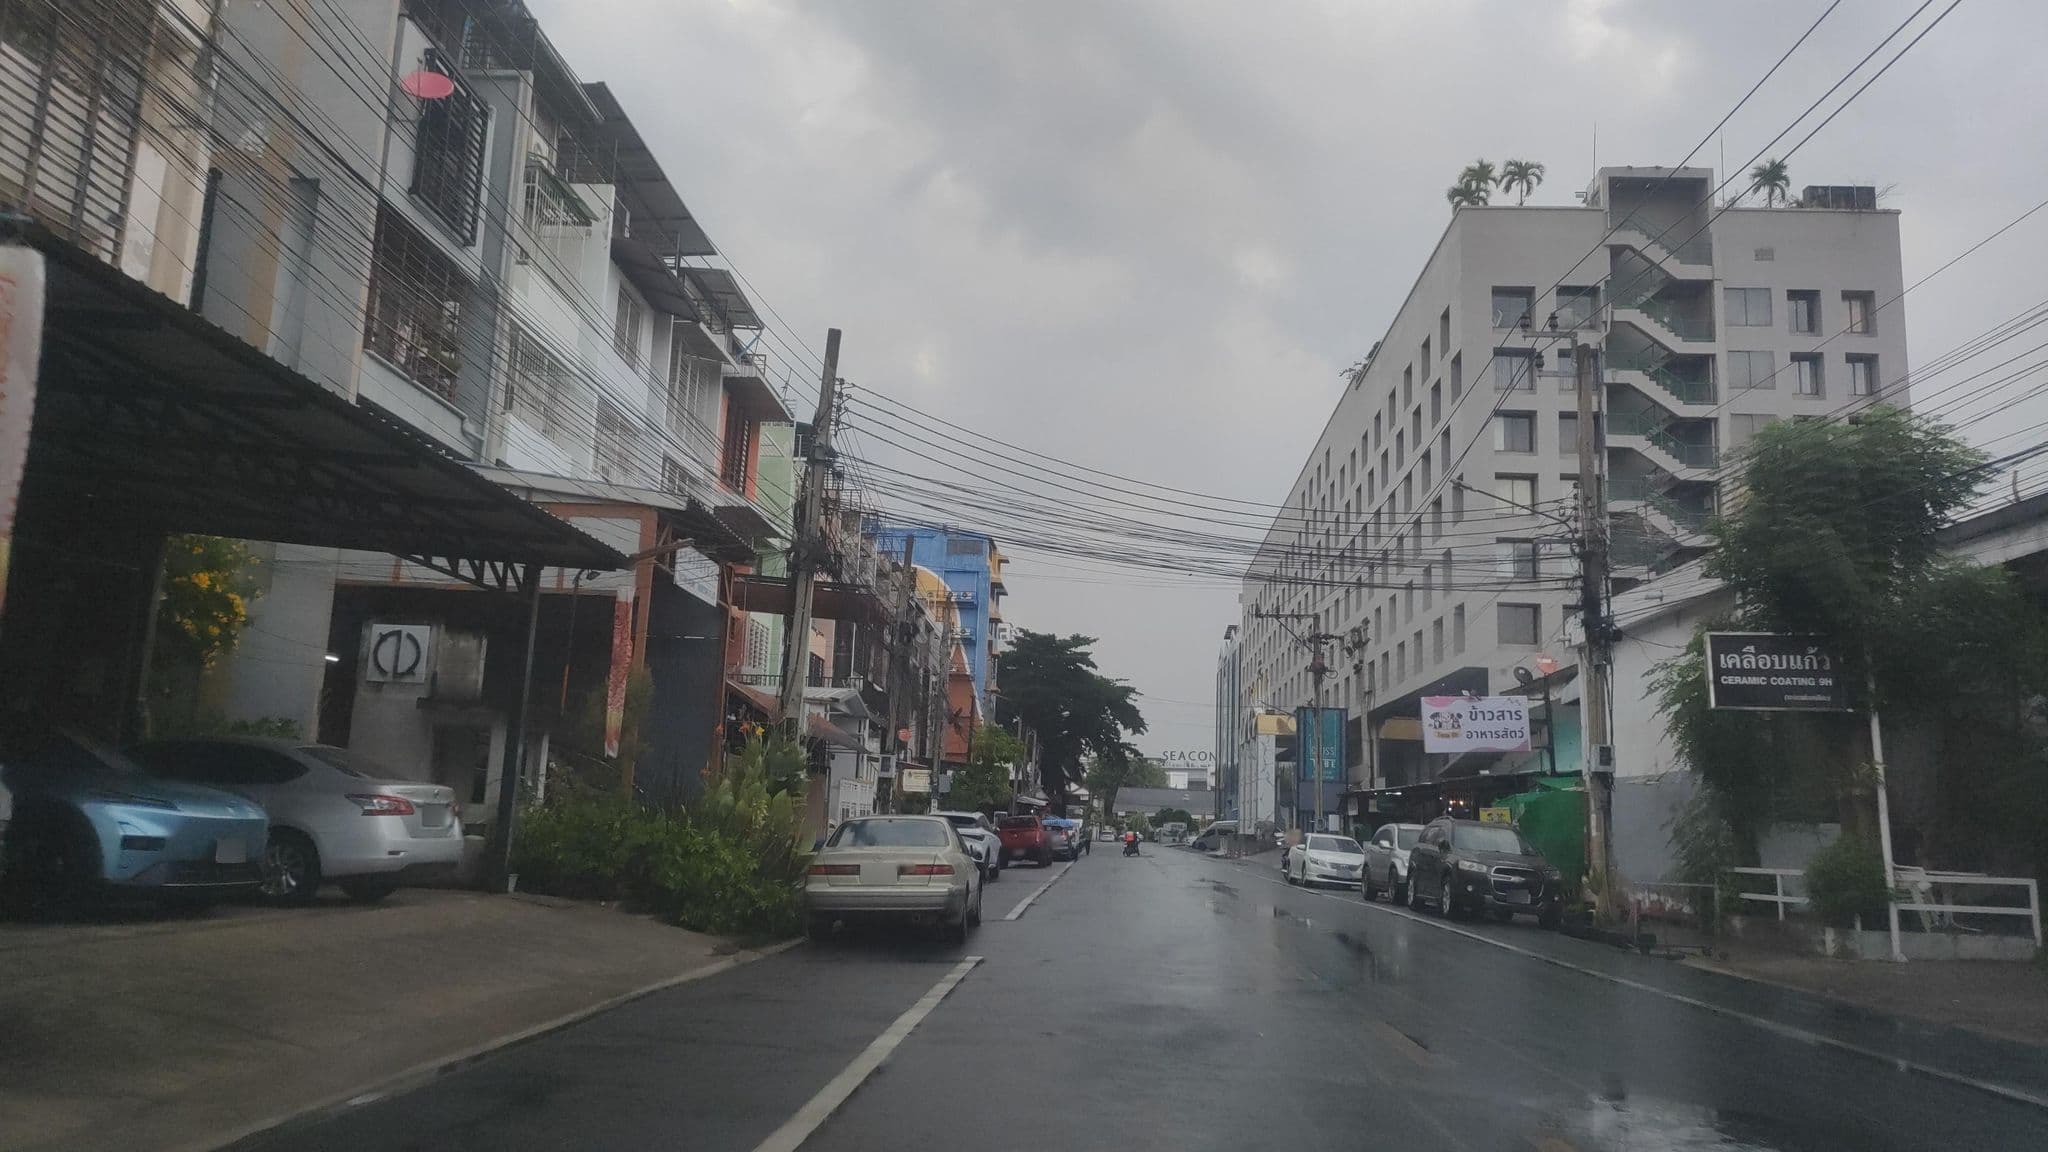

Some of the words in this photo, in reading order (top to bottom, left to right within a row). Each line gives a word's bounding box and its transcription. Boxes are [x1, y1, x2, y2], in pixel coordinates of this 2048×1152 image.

[1720, 645, 1831, 670] เคลือบแก้ว
[1720, 676, 1767, 685] CERAMIC
[1770, 677, 1816, 686] COATING
[1818, 677, 1832, 686] 9H
[1469, 705, 1522, 721] ข้าวสาร
[1466, 726, 1525, 739] อาหารสัตว์
[1162, 750, 1216, 761] SEACON
